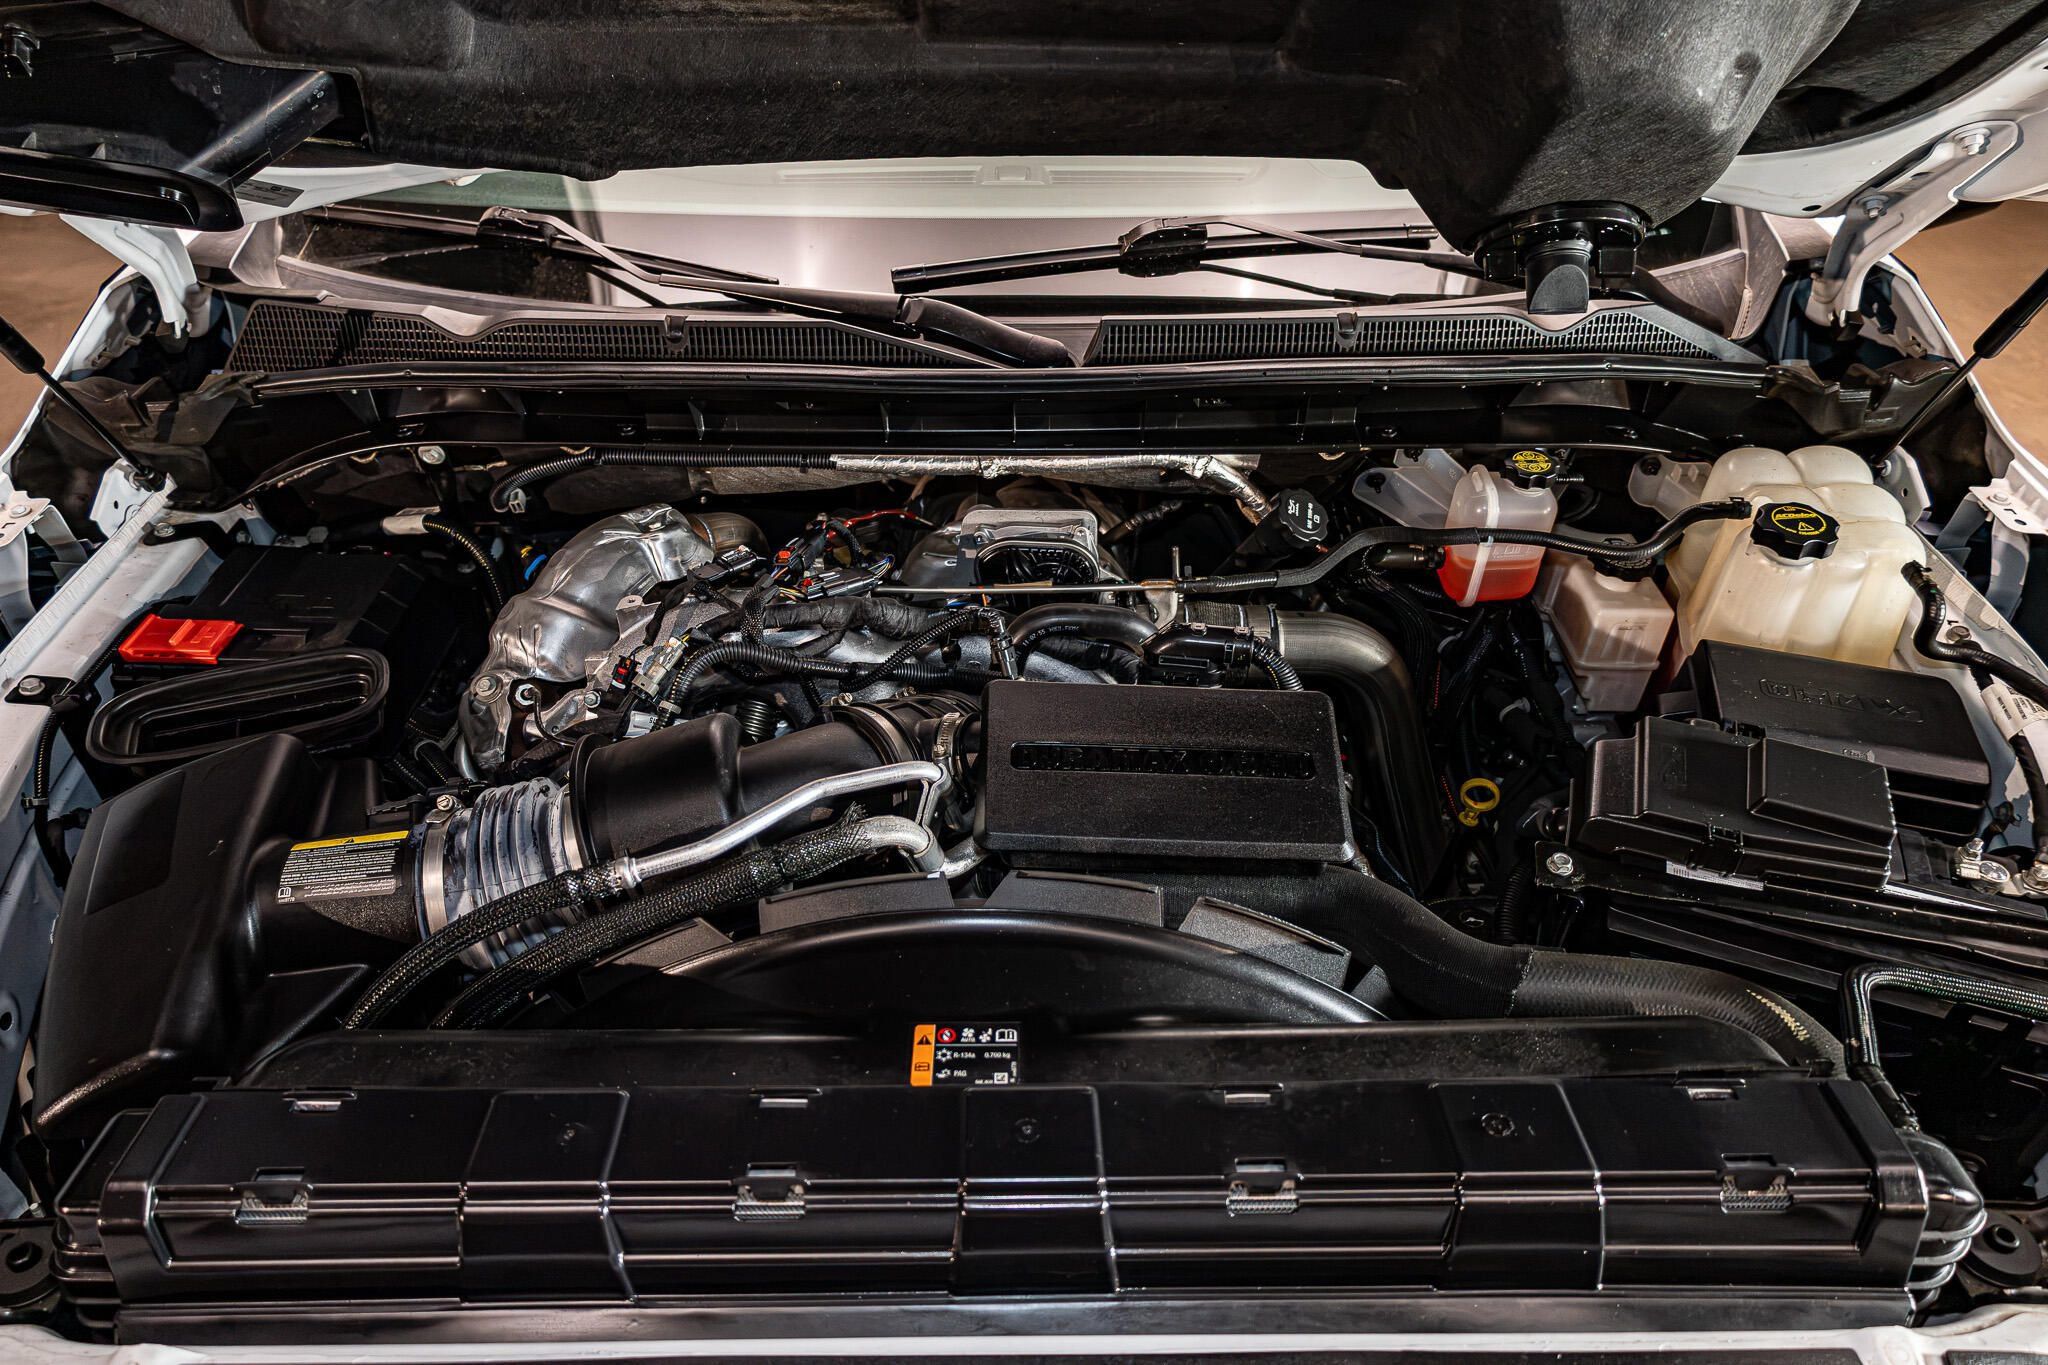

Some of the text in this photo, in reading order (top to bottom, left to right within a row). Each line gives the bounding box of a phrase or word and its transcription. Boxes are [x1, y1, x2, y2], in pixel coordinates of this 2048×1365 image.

[953, 1051, 976, 1059] R-134a
[1002, 1051, 1011, 1060] kg
[953, 1069, 967, 1078] PAG
